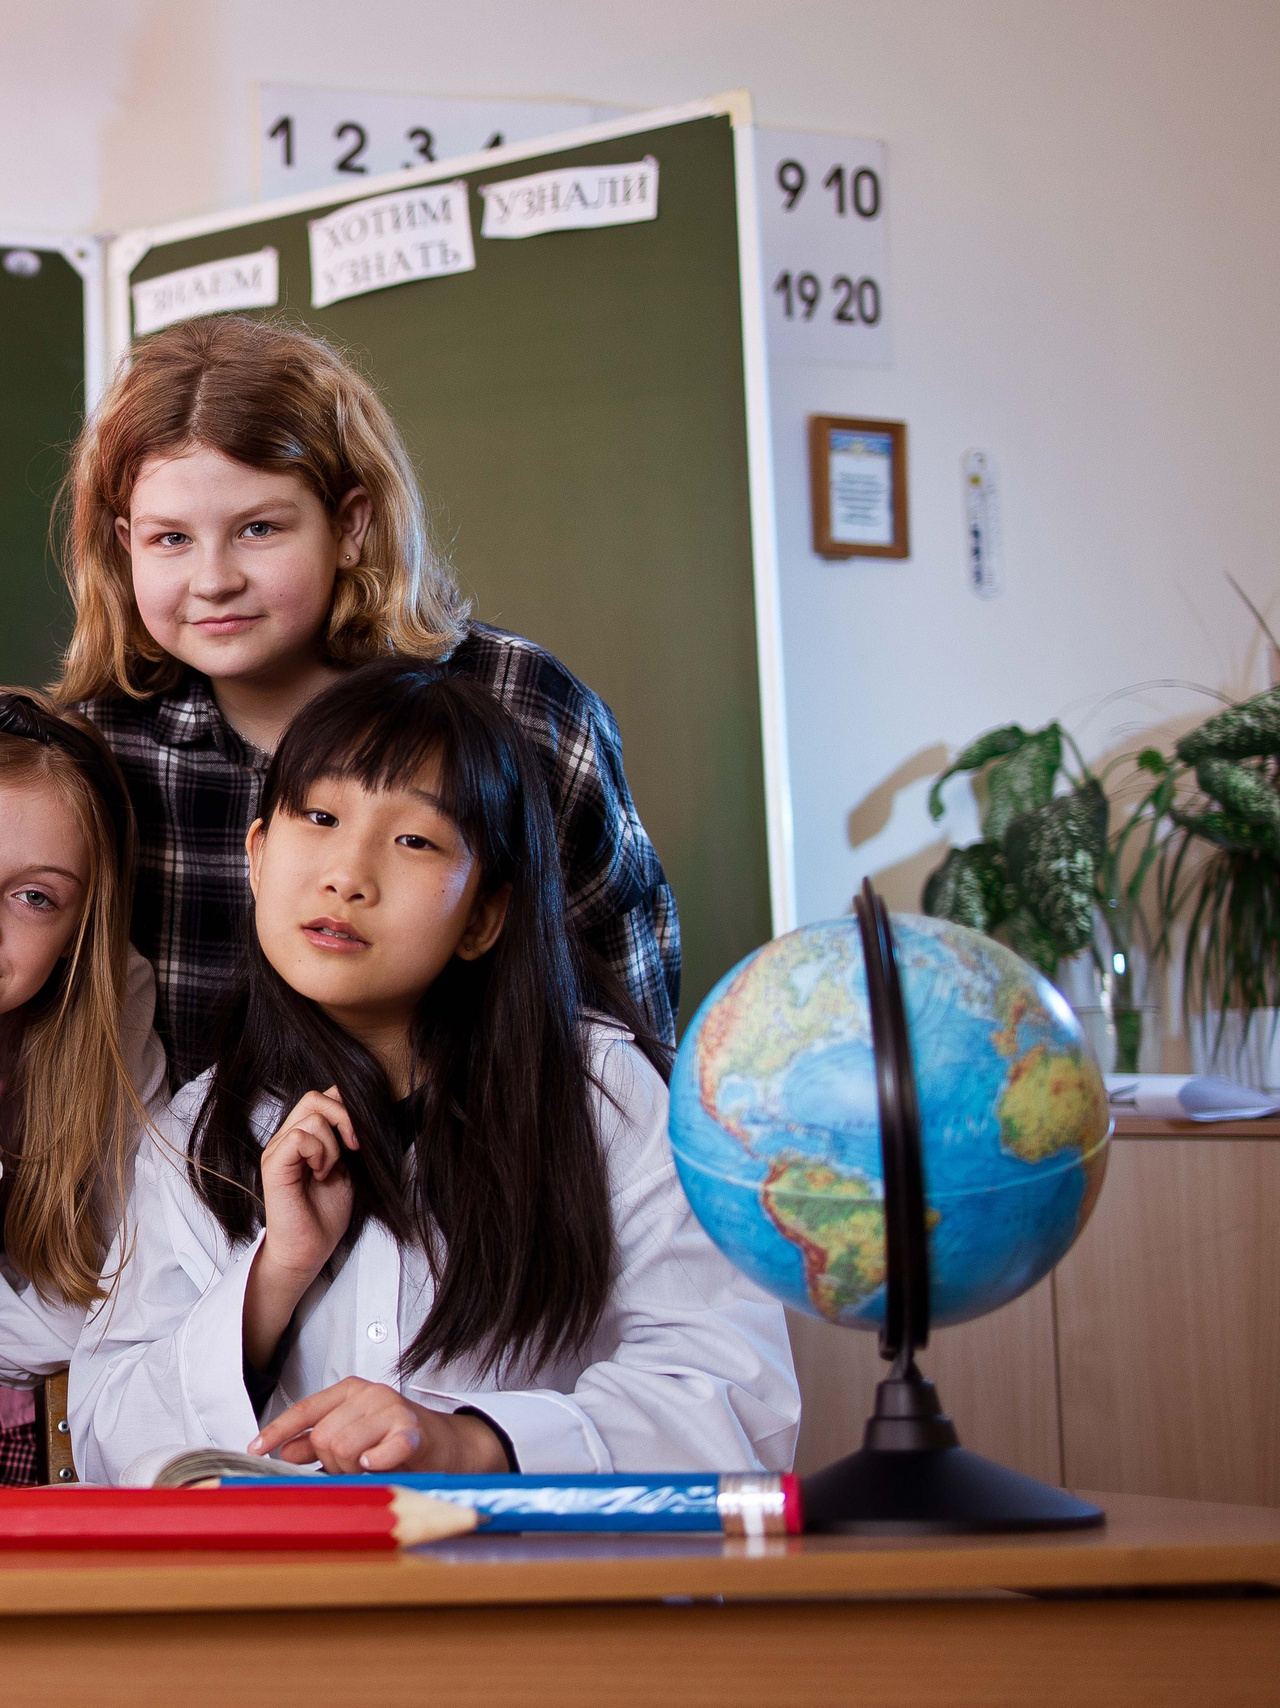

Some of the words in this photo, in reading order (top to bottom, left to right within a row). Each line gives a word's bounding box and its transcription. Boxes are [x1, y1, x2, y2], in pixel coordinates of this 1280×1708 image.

[268, 114, 295, 167] 1
[333, 120, 369, 175] 2
[403, 126, 436, 170] 3
[494, 172, 649, 224] УЗНАЛИ
[776, 158, 807, 211] 9
[824, 163, 882, 220] 10
[323, 194, 453, 258] ХОТИМ
[323, 238, 463, 294] УЗНАТЬ
[773, 269, 822, 319] 19
[831, 275, 882, 326] 20
